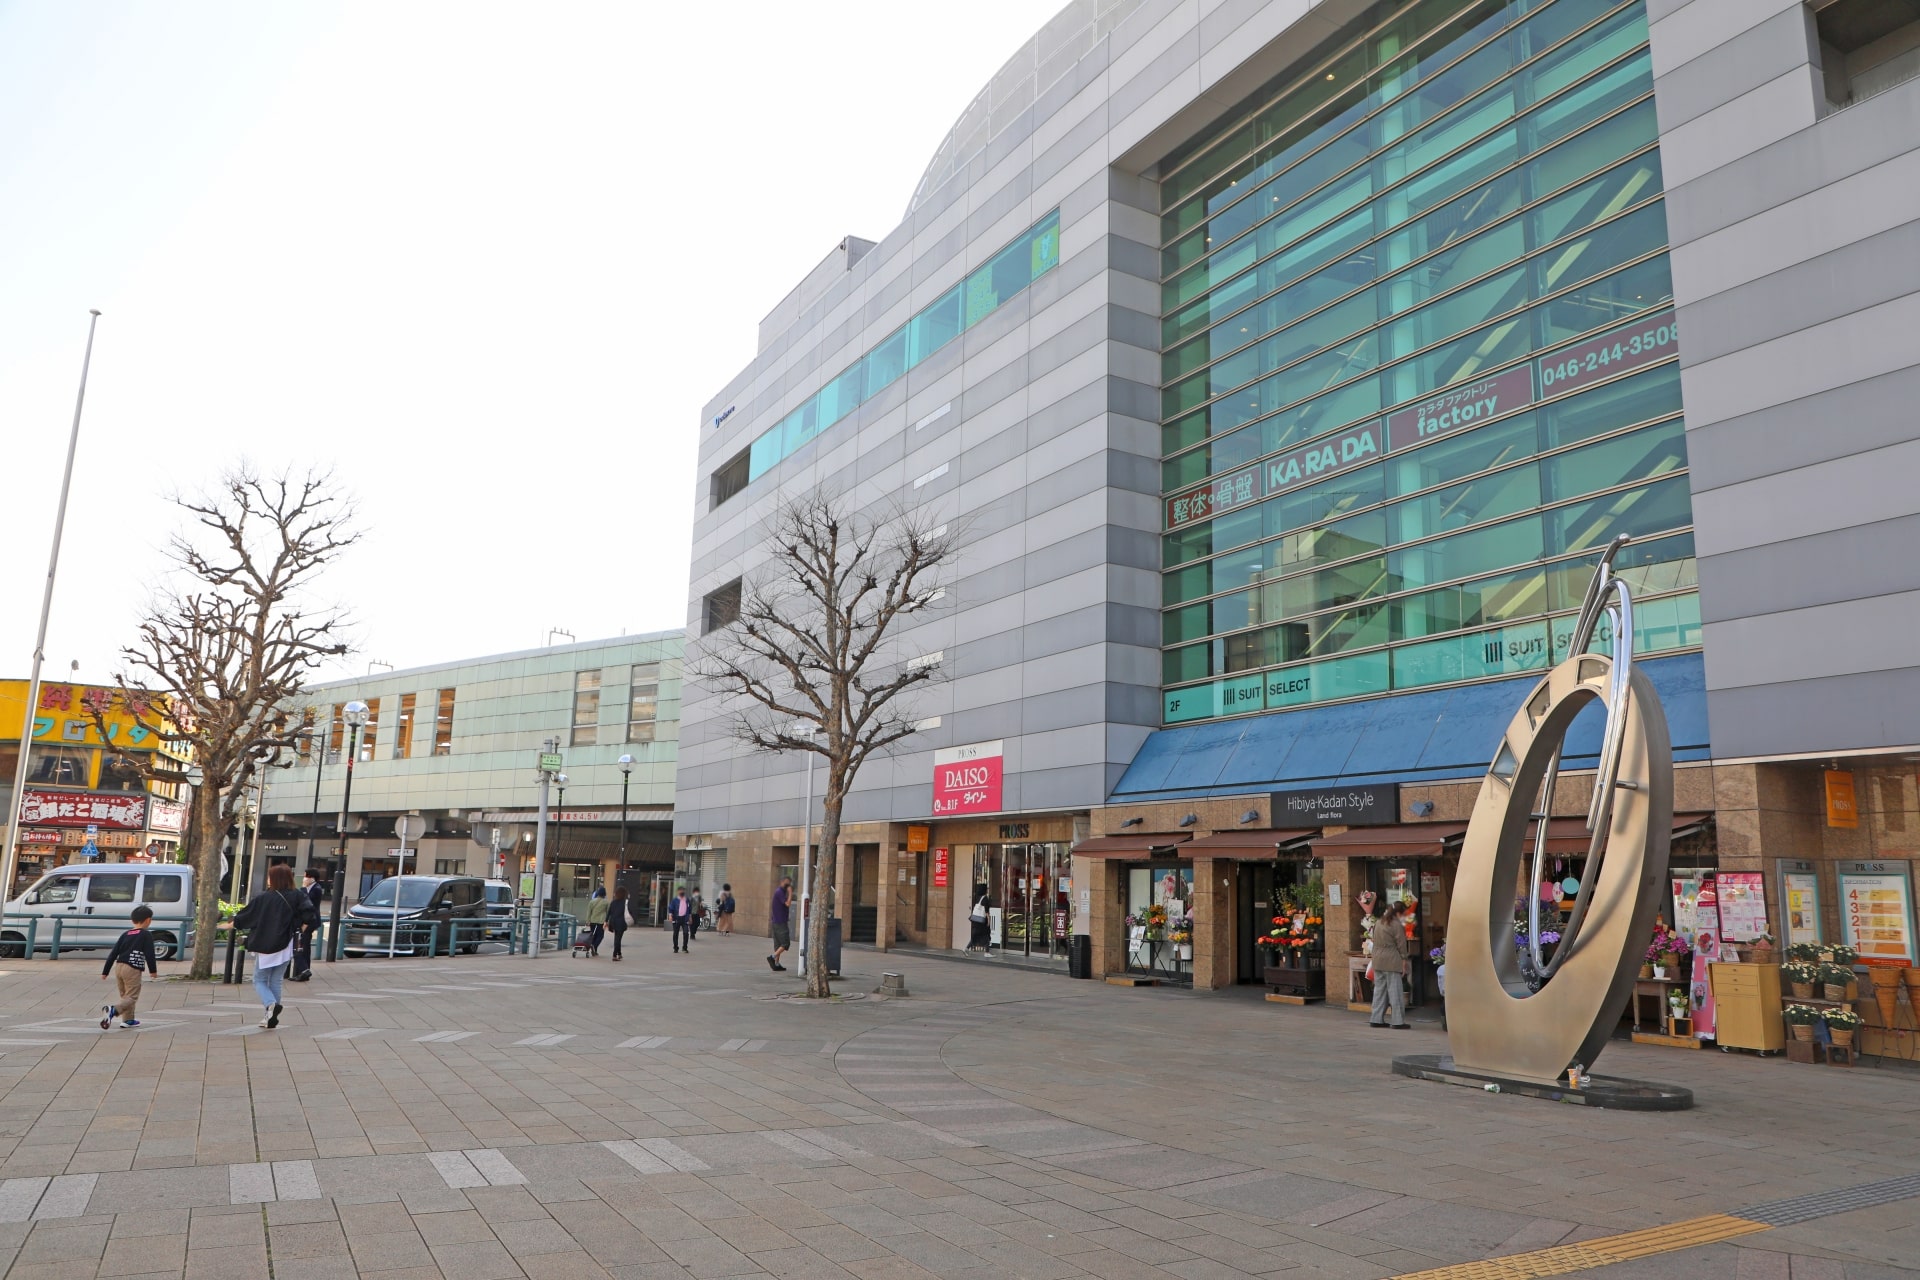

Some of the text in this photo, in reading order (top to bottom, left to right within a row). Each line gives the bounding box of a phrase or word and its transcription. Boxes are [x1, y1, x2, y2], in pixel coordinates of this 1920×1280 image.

[1543, 321, 1679, 386] 046-244-3508
[1417, 382, 1497, 417] カラダファクトリー
[1417, 395, 1498, 437] factory
[1508, 638, 1544, 657] SUIT
[1170, 678, 1310, 712] 2F SUIT SELECT
[945, 766, 988, 788] DAISO
[963, 791, 987, 804] ダイソー
[1287, 791, 1374, 812] Hibiya-Kadan Style
[1000, 824, 1030, 839] PROSS
[1849, 889, 1858, 900] 4
[1850, 902, 1859, 913] 3
[1851, 915, 1860, 926] 2
